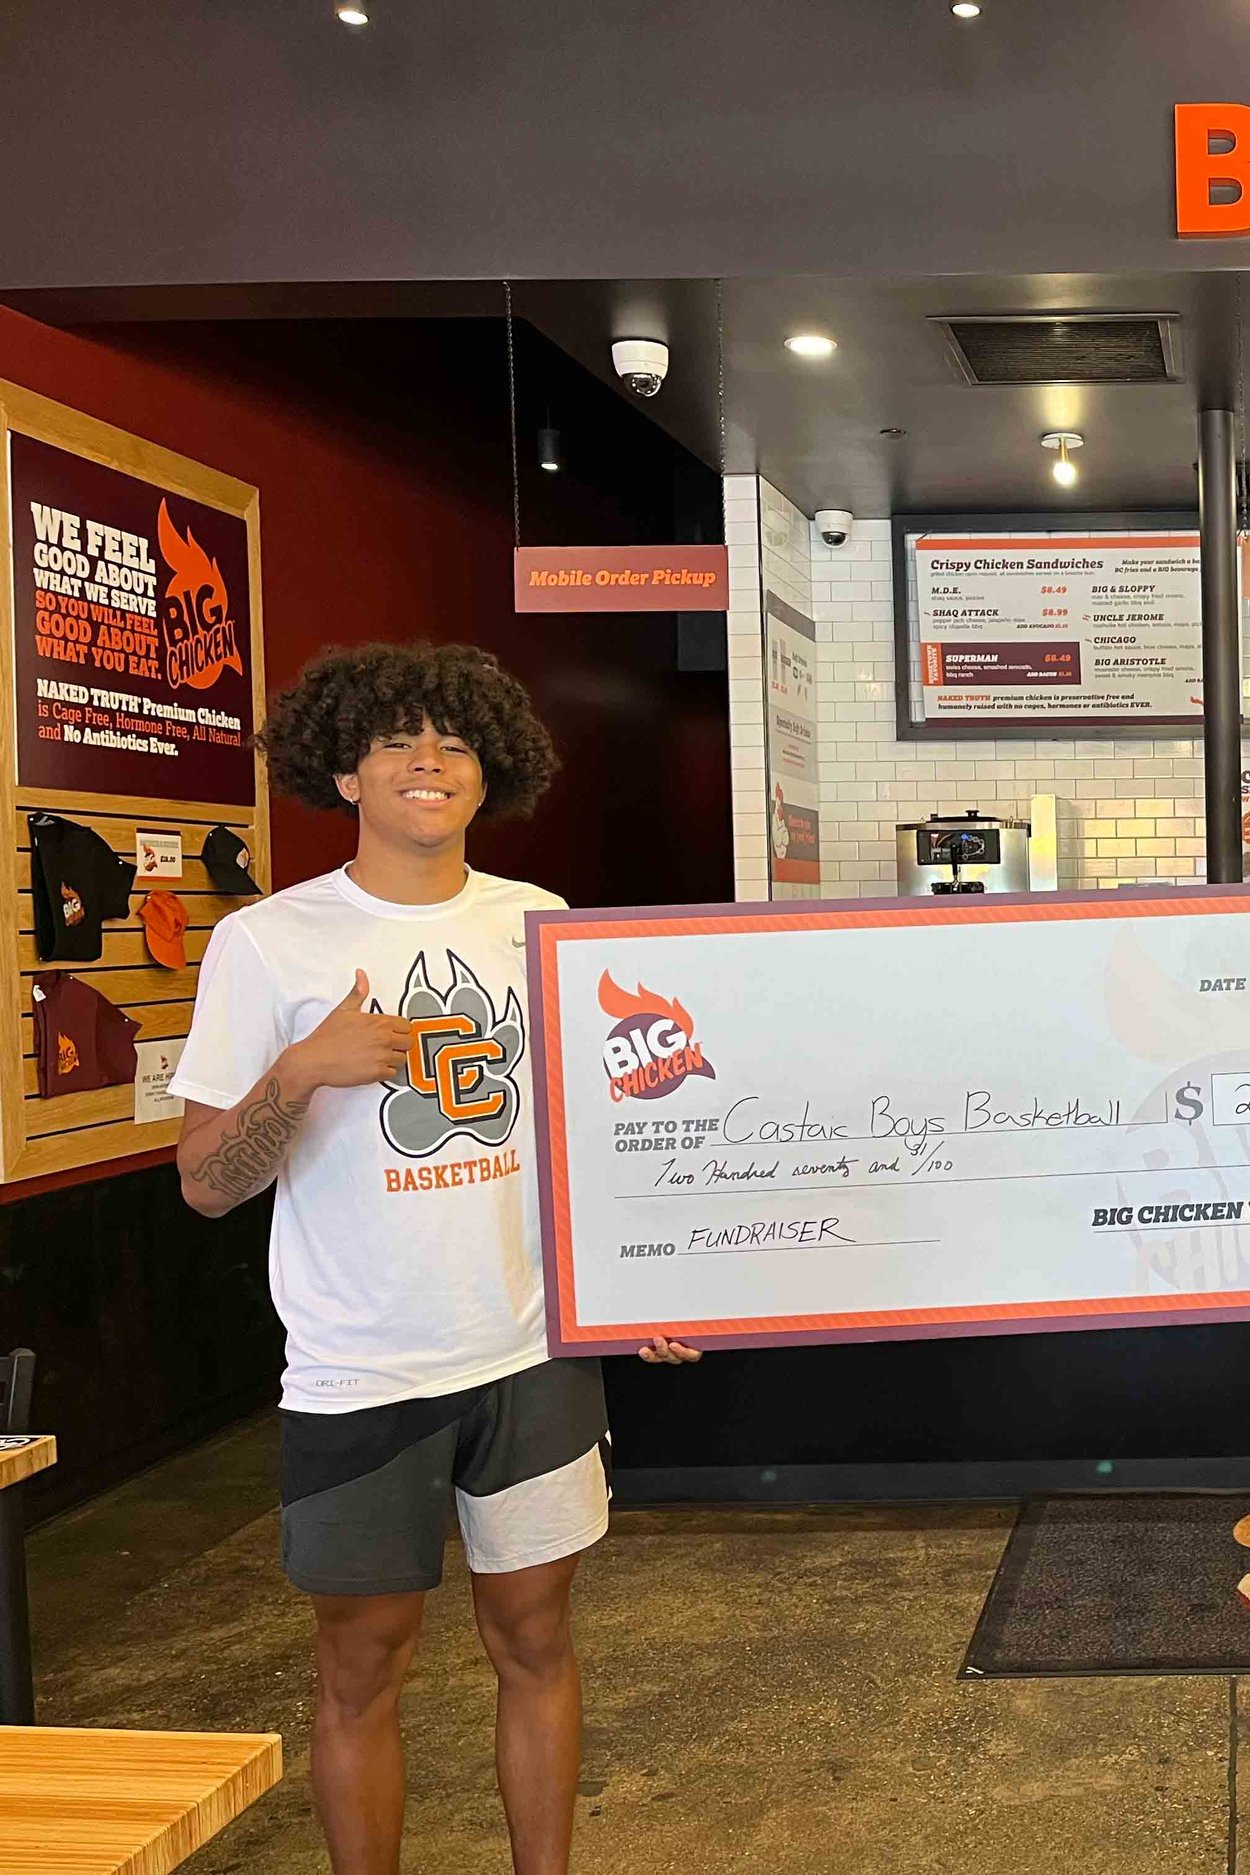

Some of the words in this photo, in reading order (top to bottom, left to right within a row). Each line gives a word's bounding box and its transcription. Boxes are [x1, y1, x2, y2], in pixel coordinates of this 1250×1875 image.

[30, 502, 80, 551] WE
[86, 519, 155, 574] FEEL
[34, 542, 90, 578] GOOD
[94, 556, 156, 597] ABOUT
[529, 570, 591, 586] Mobile
[595, 570, 649, 585] Order
[652, 569, 716, 587] Pickup
[930, 560, 971, 571] Crispy
[974, 559, 1023, 570] Chicken
[1026, 558, 1103, 569] Sandwiches
[33, 567, 81, 598] WHAT
[85, 583, 108, 604] WE
[111, 589, 156, 617] SERVE
[35, 590, 56, 612] SO
[58, 596, 89, 620] YOU
[91, 603, 124, 629] WILL
[126, 612, 157, 636] FEEL
[163, 585, 225, 641] BIG
[933, 609, 957, 618] SHAQ
[1093, 614, 1124, 622] UNCLE
[36, 612, 91, 644] GOOD
[96, 624, 158, 659] ABOUT
[1094, 636, 1136, 644] CHICAGO
[35, 635, 87, 666] WHAT
[92, 647, 125, 672] YOU
[128, 656, 162, 680] EAT.
[167, 620, 235, 689] CHICKEN
[946, 654, 998, 662] SUPERMAN
[1095, 658, 1110, 666] BIG
[37, 679, 89, 704] NAKED
[91, 687, 140, 712] TRUTH
[142, 697, 196, 723] Premium
[198, 708, 240, 730] Chicken
[38, 700, 48, 717] is
[53, 705, 81, 726] Cage
[85, 710, 112, 728] Free,
[116, 715, 162, 735] Hormone
[166, 722, 190, 741] Free,
[193, 725, 206, 742] All
[209, 727, 240, 747] Natural
[38, 723, 61, 741] and
[64, 725, 81, 743] No
[83, 728, 148, 753] Antibiotics
[150, 738, 178, 756] Ever.
[63, 899, 81, 917] BIG
[1199, 978, 1246, 992] DATE
[605, 1019, 687, 1079] BIG
[609, 1042, 703, 1103] CHICKEN
[1174, 1081, 1203, 1126] $
[614, 1122, 648, 1136] PAY
[652, 1121, 678, 1134] TO
[682, 1118, 719, 1132] THE
[869, 1096, 945, 1153] Boys
[964, 1091, 1120, 1132] Basketball
[615, 1138, 676, 1152] ORDER
[680, 1136, 705, 1150] OF
[385, 1150, 520, 1193] BASKETBALL
[869, 1157, 900, 1172] and
[1092, 1206, 1132, 1227] BIG
[1138, 1201, 1243, 1222] CHICKEN
[688, 1217, 856, 1249] FUNDRAISER
[620, 1243, 675, 1257] MEMO
